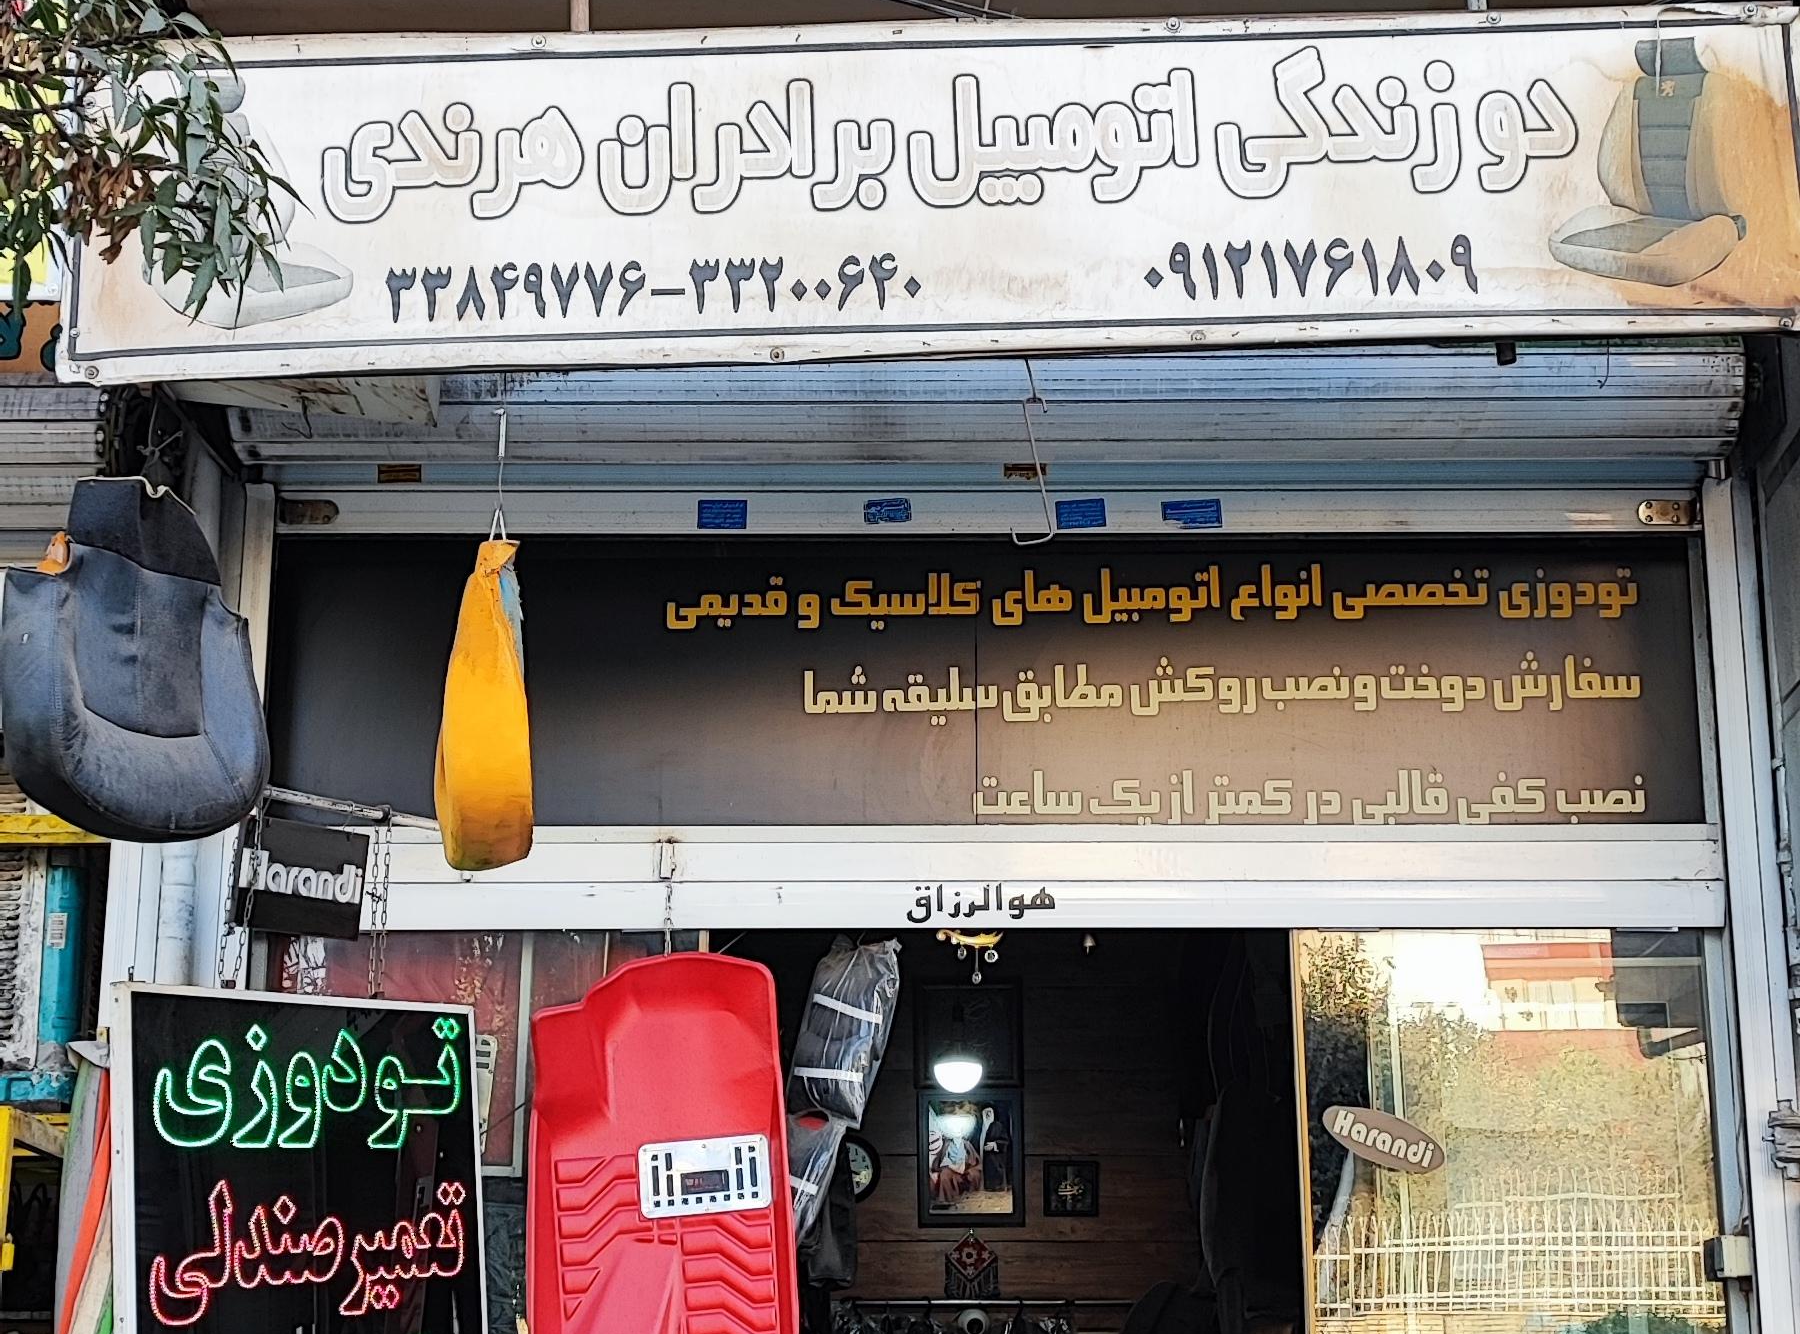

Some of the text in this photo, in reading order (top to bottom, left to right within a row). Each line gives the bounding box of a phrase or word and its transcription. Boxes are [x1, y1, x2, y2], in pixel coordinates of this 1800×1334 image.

[323, 101, 583, 223] هرندی
[600, 78, 894, 215] برادران
[908, 67, 1197, 207] اتومبیل
[1144, 233, 1479, 298] ۰۹۱۲۱۷۶۱۸۰۹
[666, 564, 1637, 630] تودوزی تخصصی انواع اتومبیل های کلاسیک و قدیمی
[804, 665, 877, 714] شما
[882, 667, 998, 726] سلیقه
[1002, 664, 1123, 722] مطابق
[1130, 656, 1256, 715] روکش
[1493, 651, 1641, 711] سفارش
[973, 770, 1646, 824] نصب کفی قالبی در کمتر از یک ساعت
[239, 847, 363, 904] Harandi
[153, 1016, 461, 1149] تودوزی
[1333, 1109, 1435, 1168] Harandi
[150, 1179, 466, 1326] تعمیر صندلی
